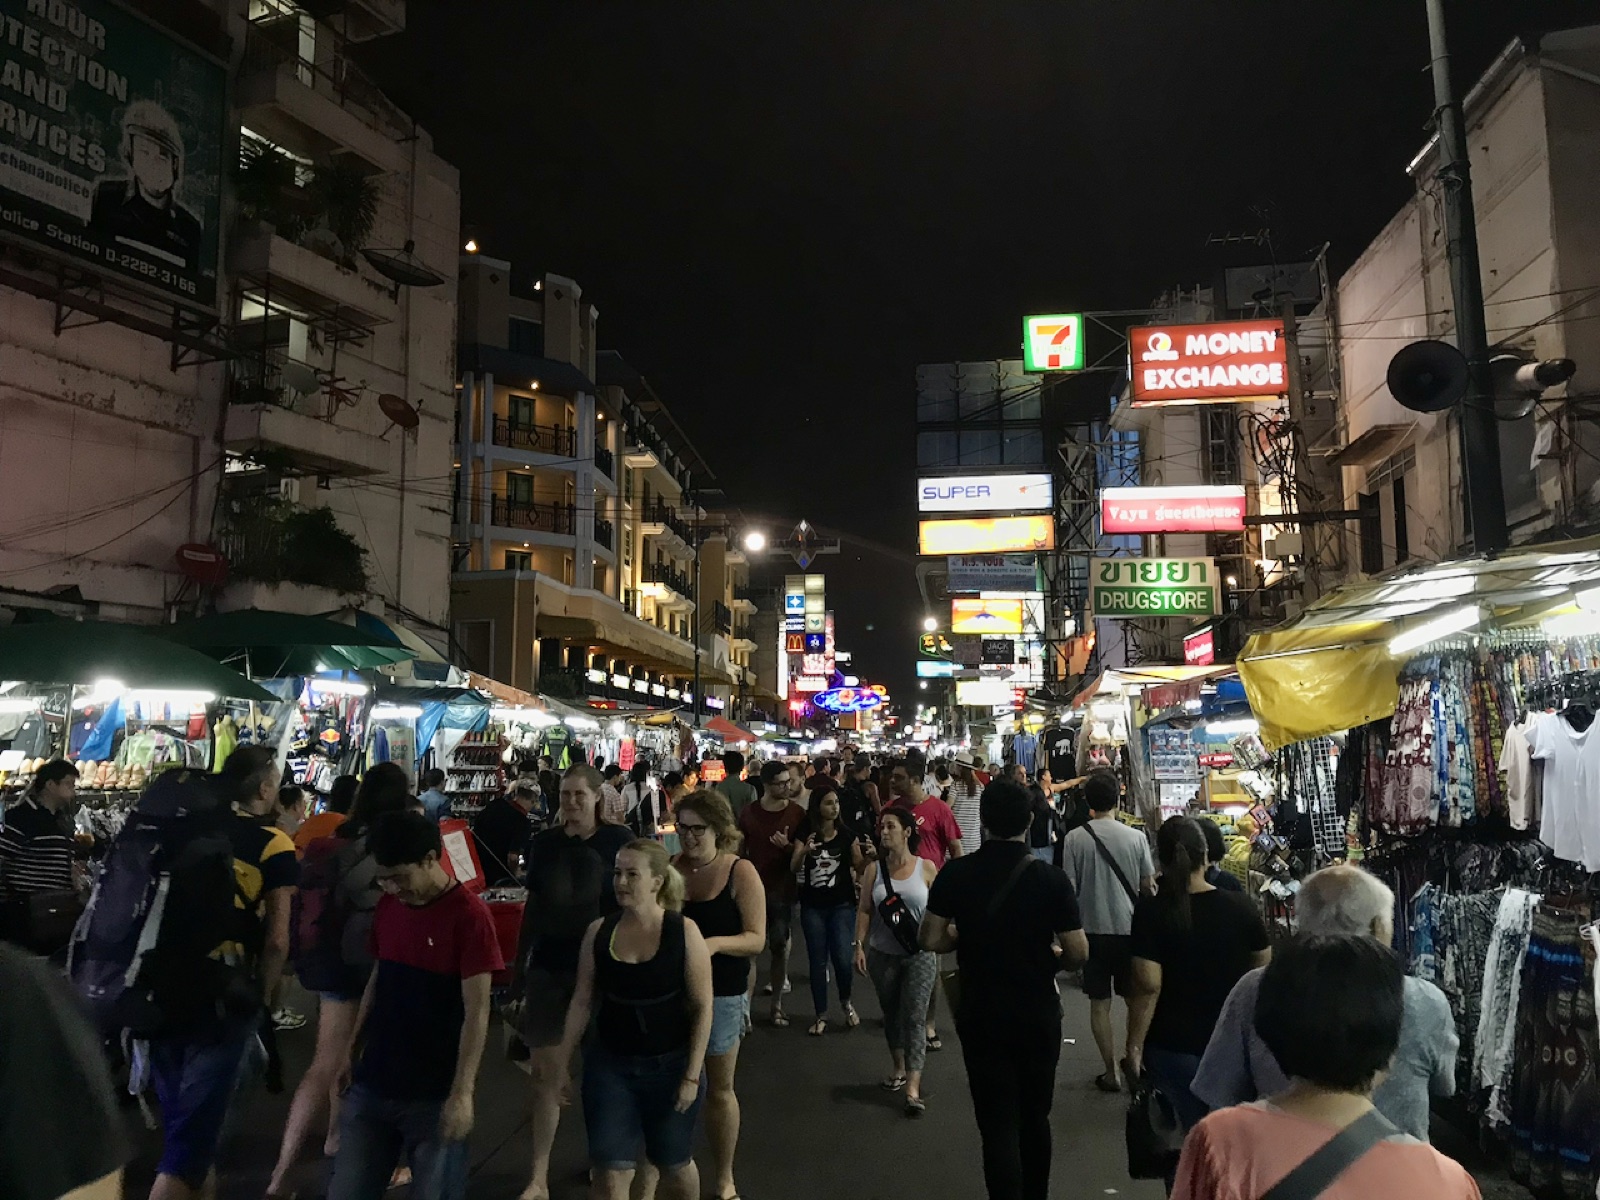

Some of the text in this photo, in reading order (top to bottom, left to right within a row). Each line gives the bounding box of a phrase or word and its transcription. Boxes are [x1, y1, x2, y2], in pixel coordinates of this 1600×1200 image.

[26, 0, 106, 51] HOUR
[0, 10, 128, 103] TECTION
[1, 59, 67, 112] AND
[0, 204, 39, 231] olice
[45, 223, 100, 256] Station
[1185, 331, 1276, 356] MONEY
[1143, 363, 1283, 390] EXCHANGE
[922, 485, 991, 499] SUPER
[1109, 505, 1241, 522] Vayu guesthouse
[983, 557, 1005, 566] TOUR
[1099, 562, 1207, 584] ขายยา
[1100, 591, 1207, 609] DRUGSTORE
